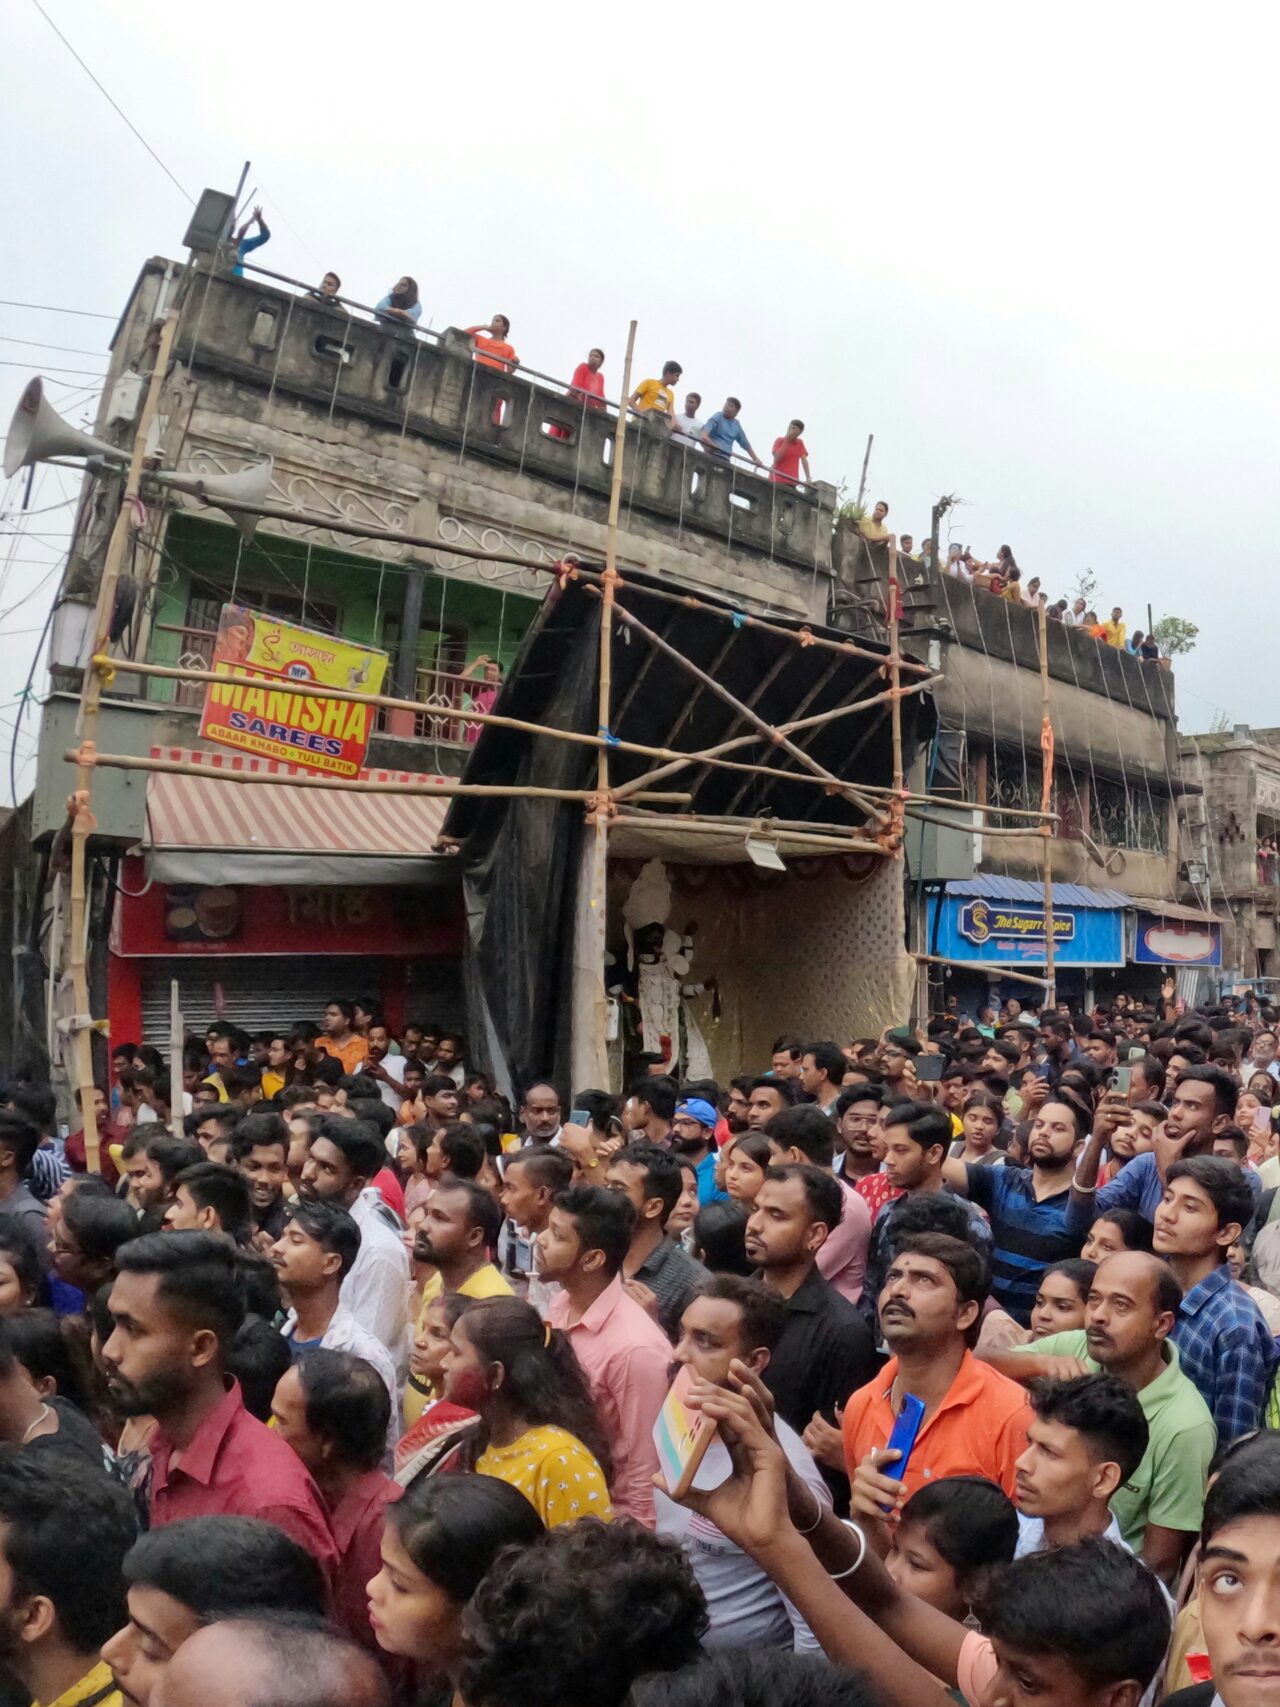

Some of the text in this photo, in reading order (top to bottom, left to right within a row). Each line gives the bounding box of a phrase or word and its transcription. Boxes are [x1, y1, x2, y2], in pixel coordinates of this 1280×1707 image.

[211, 662, 366, 745] MANISHA
[211, 727, 353, 774] ABAAR KHABO TULI BATIK
[229, 711, 343, 756] SAREES
[993, 915, 1012, 928] The
[1012, 916, 1043, 934] Sugarr
